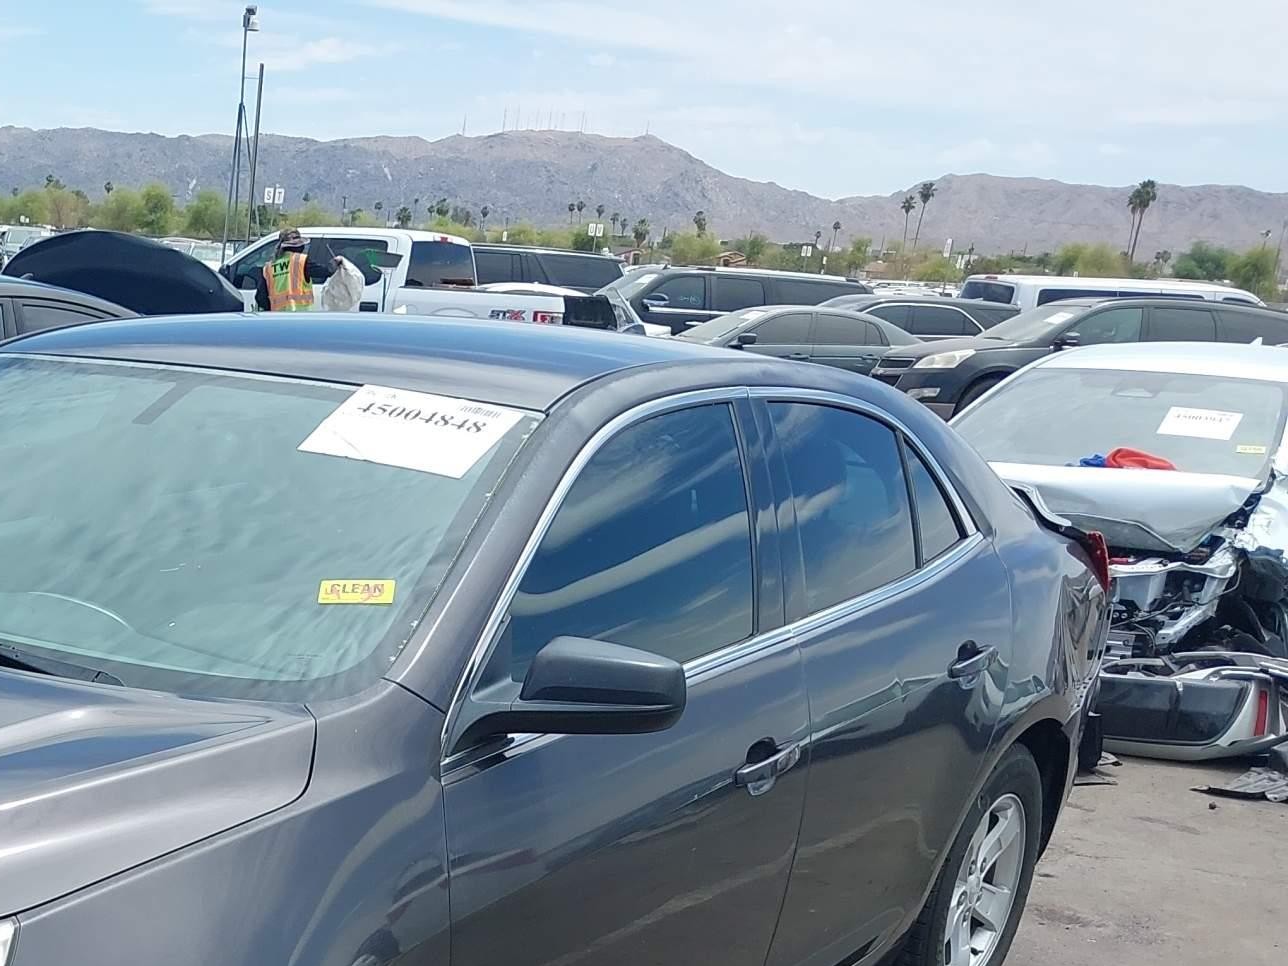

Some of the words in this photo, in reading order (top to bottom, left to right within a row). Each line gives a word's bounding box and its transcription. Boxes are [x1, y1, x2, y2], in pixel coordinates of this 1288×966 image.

[266, 191, 272, 201] S
[277, 192, 283, 201] T
[272, 261, 290, 273] TW
[357, 401, 487, 434] 45004848
[330, 583, 385, 594] CLEAN
